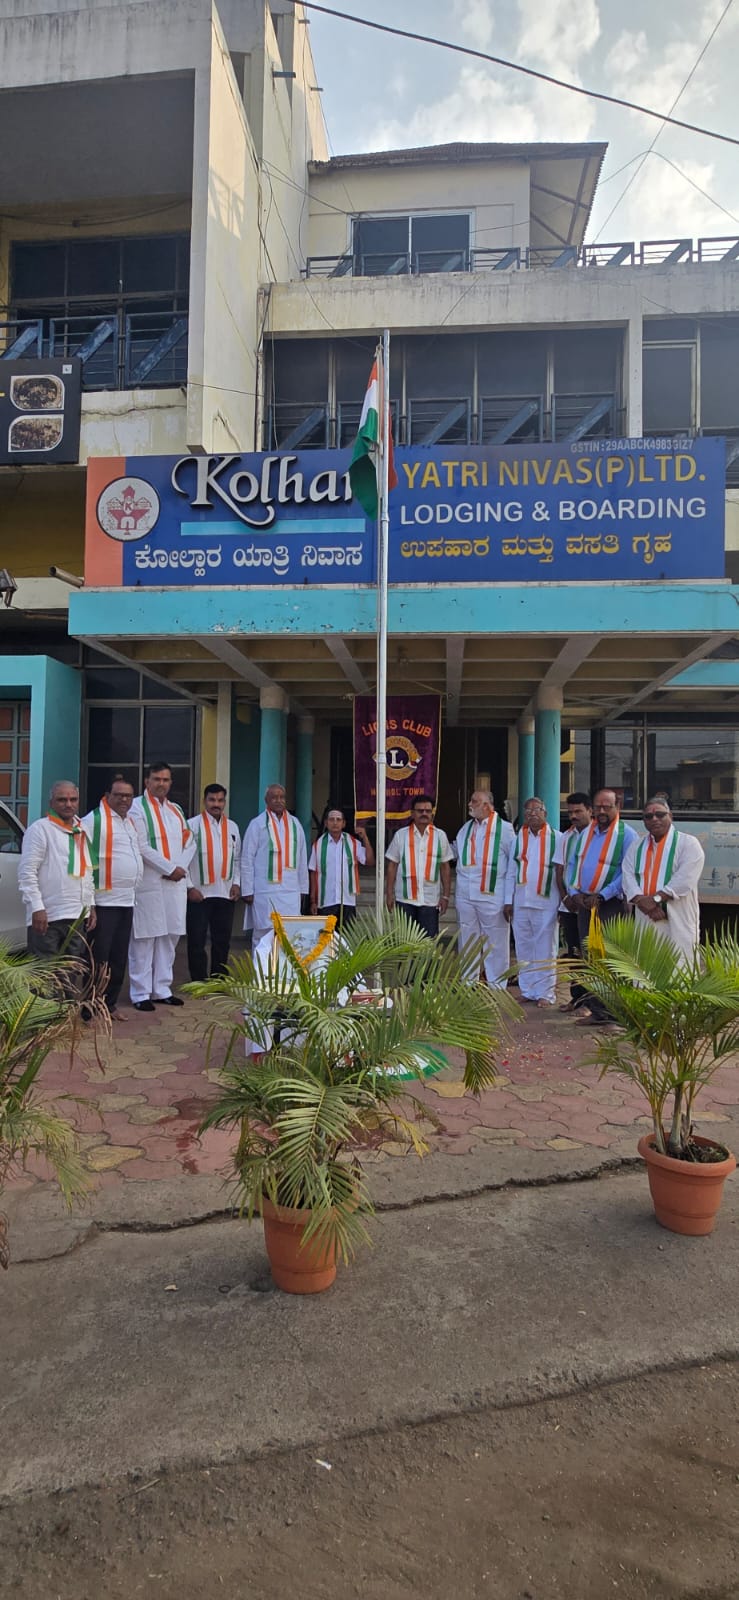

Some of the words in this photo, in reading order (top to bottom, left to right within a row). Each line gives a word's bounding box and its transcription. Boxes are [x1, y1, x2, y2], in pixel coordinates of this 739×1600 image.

[402, 460, 488, 489] YATRI
[401, 501, 523, 525] LODGING
[531, 500, 551, 522] &
[558, 497, 707, 521] BOARDING
[134, 544, 222, 577] ಕೋಲ್ಹಾರ
[232, 543, 290, 575] ಯಾತ್ರಿ
[301, 541, 363, 567] ನಿವಾಸ
[400, 536, 490, 558] ಉಪಹಾರ
[502, 534, 554, 563] ಮತ್ತು
[566, 533, 620, 555] ವಸತಿ
[632, 532, 672, 564] ಗೃಹ
[402, 719, 432, 737] CLUB
[390, 750, 404, 767] L
[403, 787, 425, 796] TOWN
